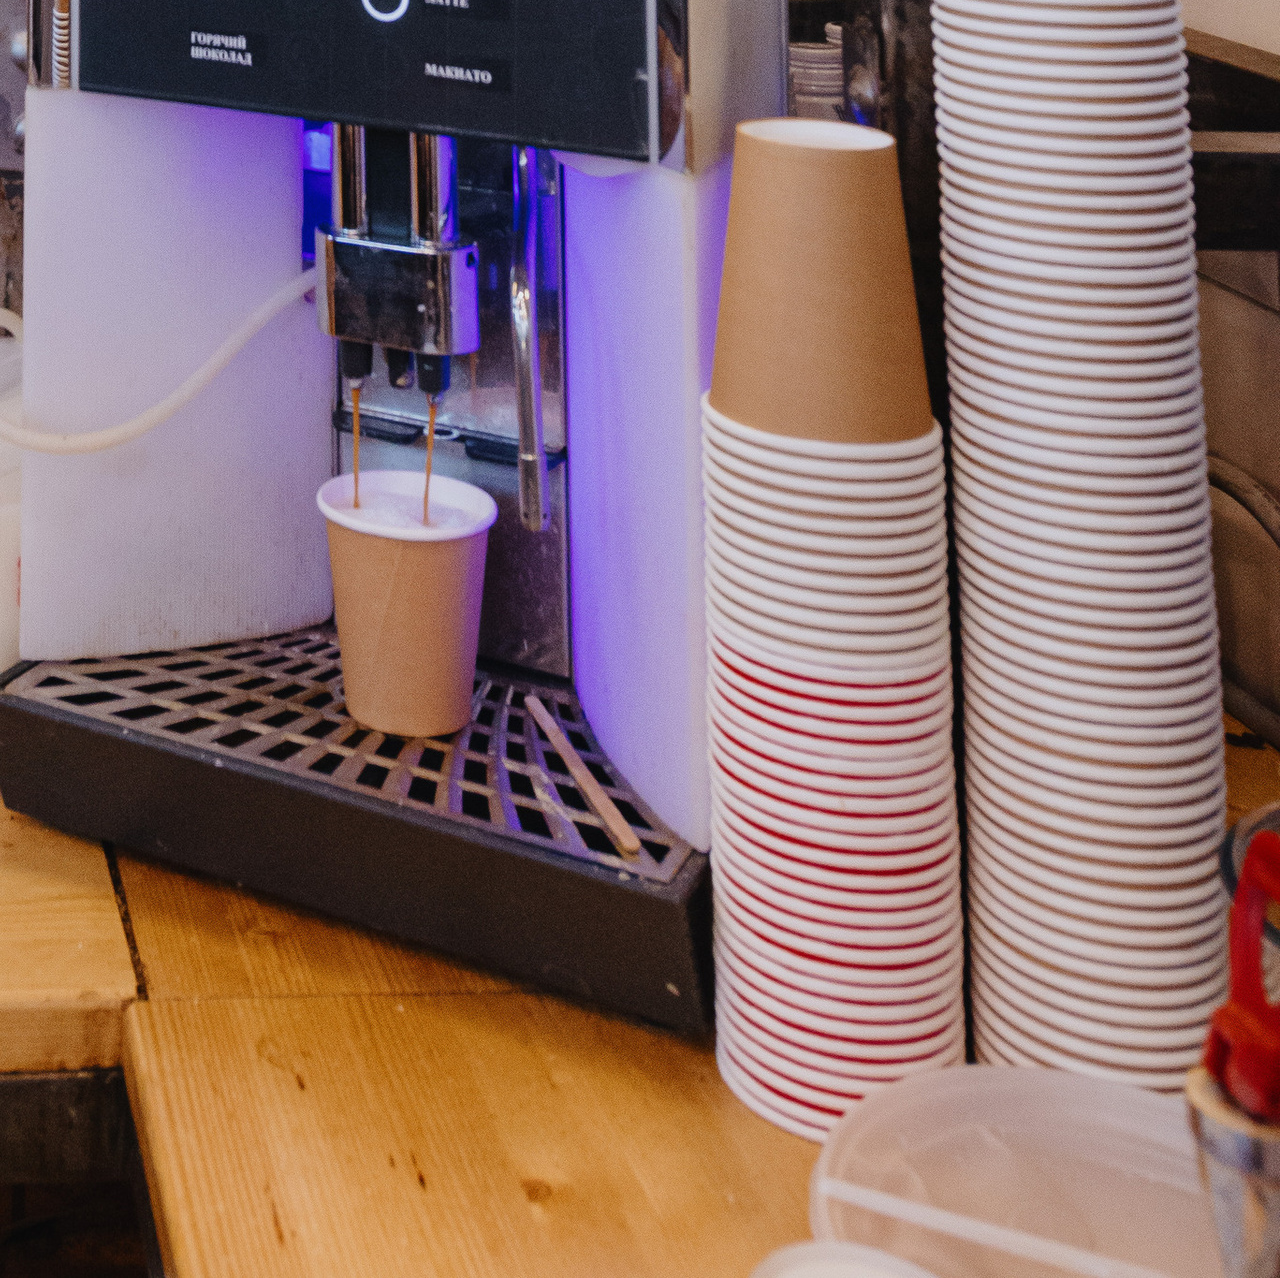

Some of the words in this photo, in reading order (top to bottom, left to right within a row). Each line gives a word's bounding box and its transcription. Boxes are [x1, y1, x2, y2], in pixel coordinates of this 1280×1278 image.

[190, 31, 247, 50] ГОРЯЧИЙ
[190, 46, 253, 67] ШОКОЛАД
[424, 62, 493, 85] МАКИАТО
